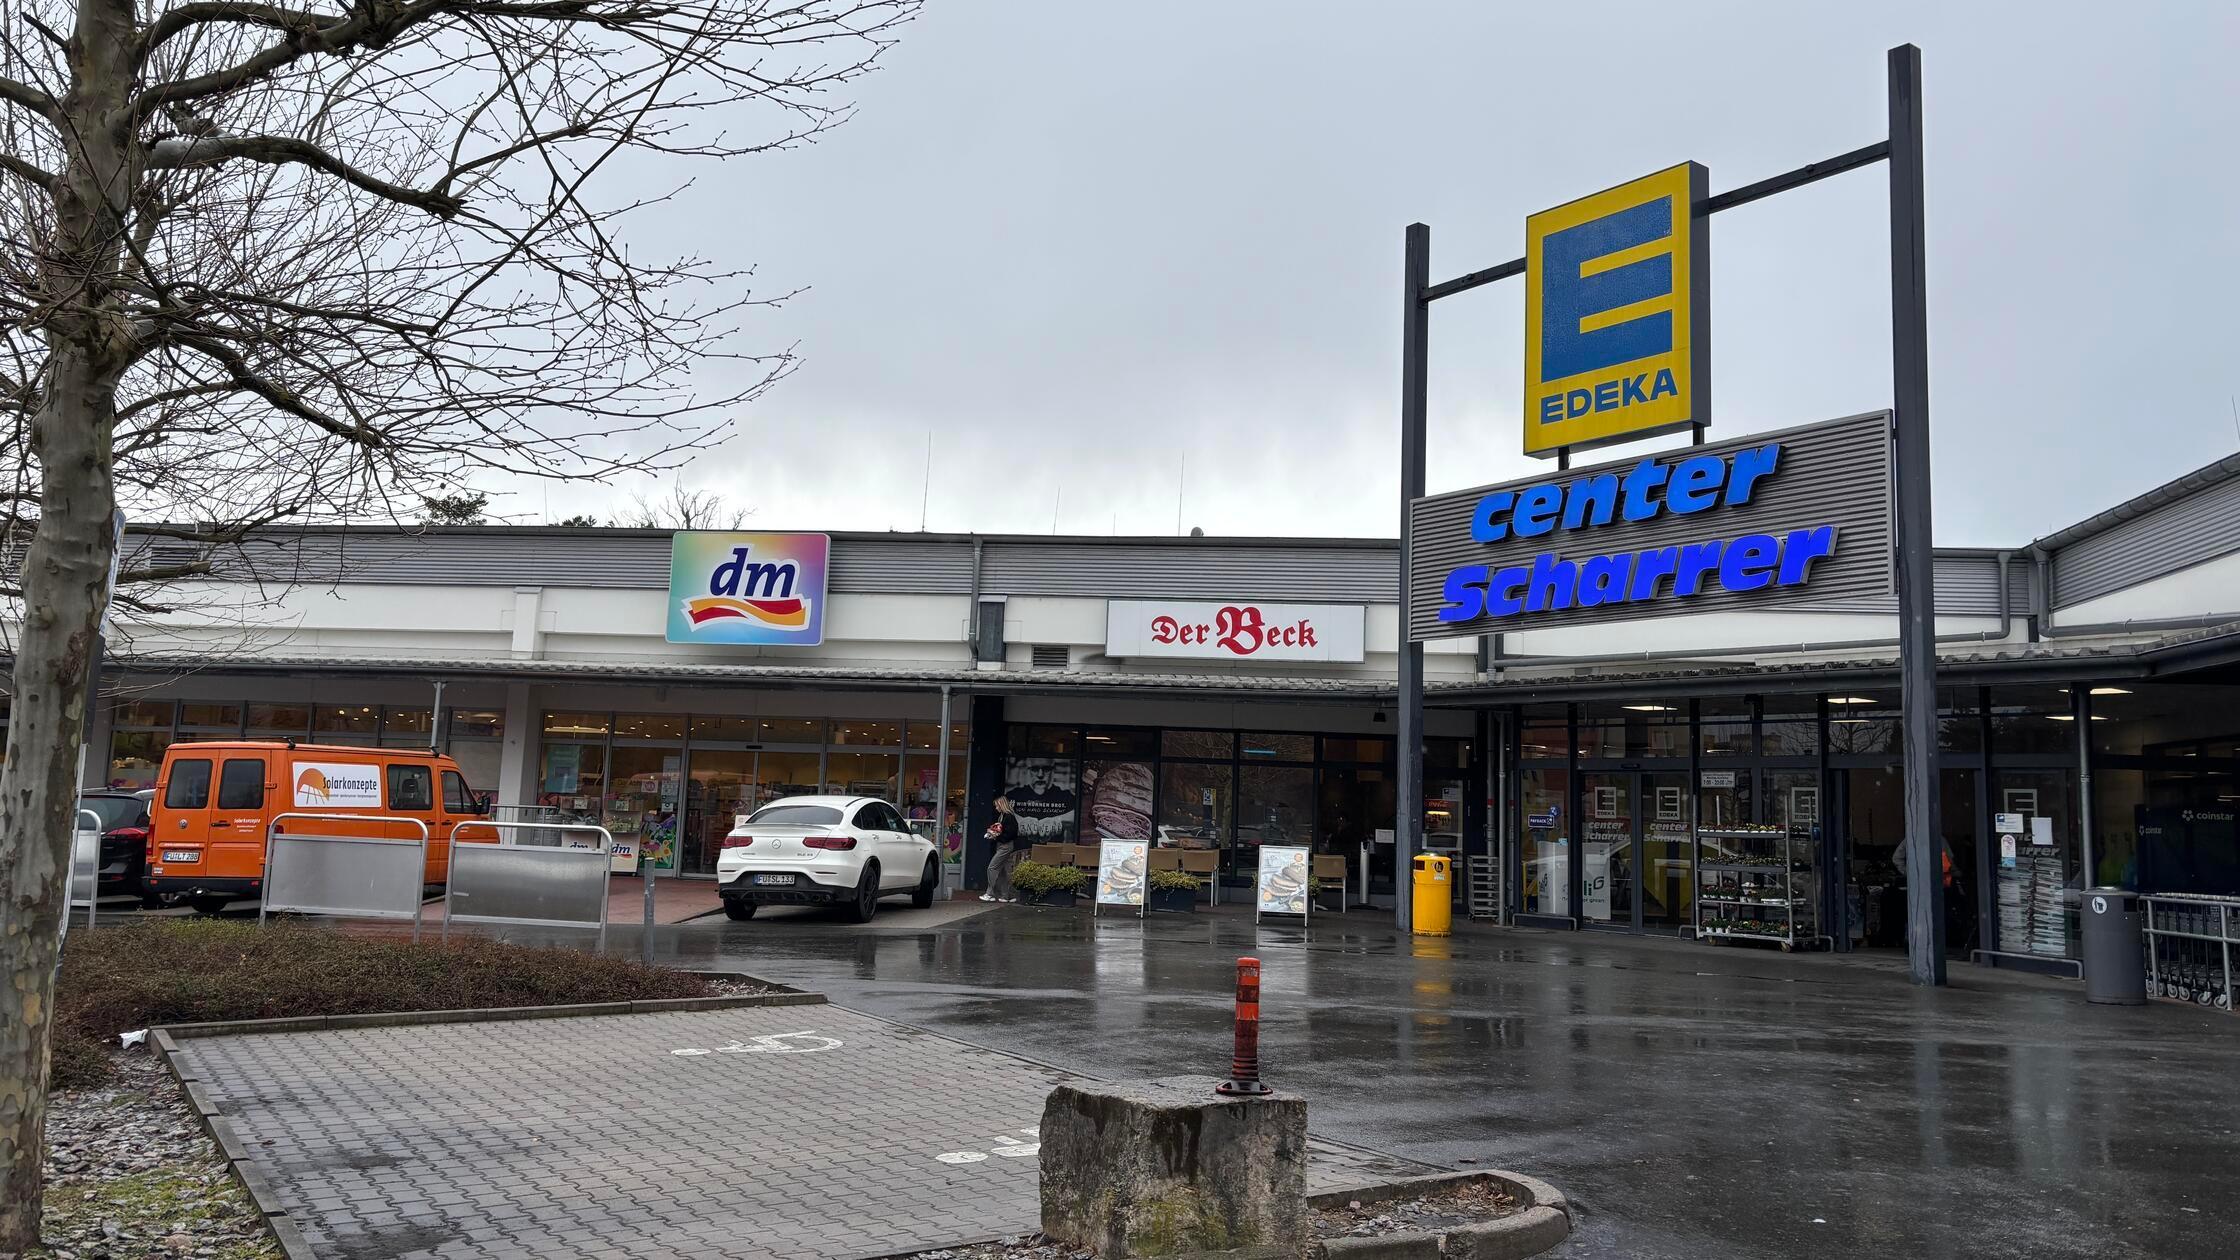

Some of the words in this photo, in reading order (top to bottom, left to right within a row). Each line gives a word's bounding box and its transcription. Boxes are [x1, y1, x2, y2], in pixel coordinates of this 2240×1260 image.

[1541, 193, 1673, 385] E
[1540, 367, 1679, 425] EDEKA
[1470, 442, 1784, 544] center
[709, 547, 796, 598] dm
[1438, 524, 1838, 623] Scharrer
[1151, 615, 1210, 645] Der
[1215, 606, 1319, 656] Beck
[322, 776, 377, 793] Solarkonzepte
[1588, 821, 1625, 830] center
[1649, 822, 1688, 831] center
[2196, 811, 2235, 821] coinstar
[612, 844, 631, 854] dm
[771, 875, 780, 885] SL
[782, 875, 794, 885] 133
